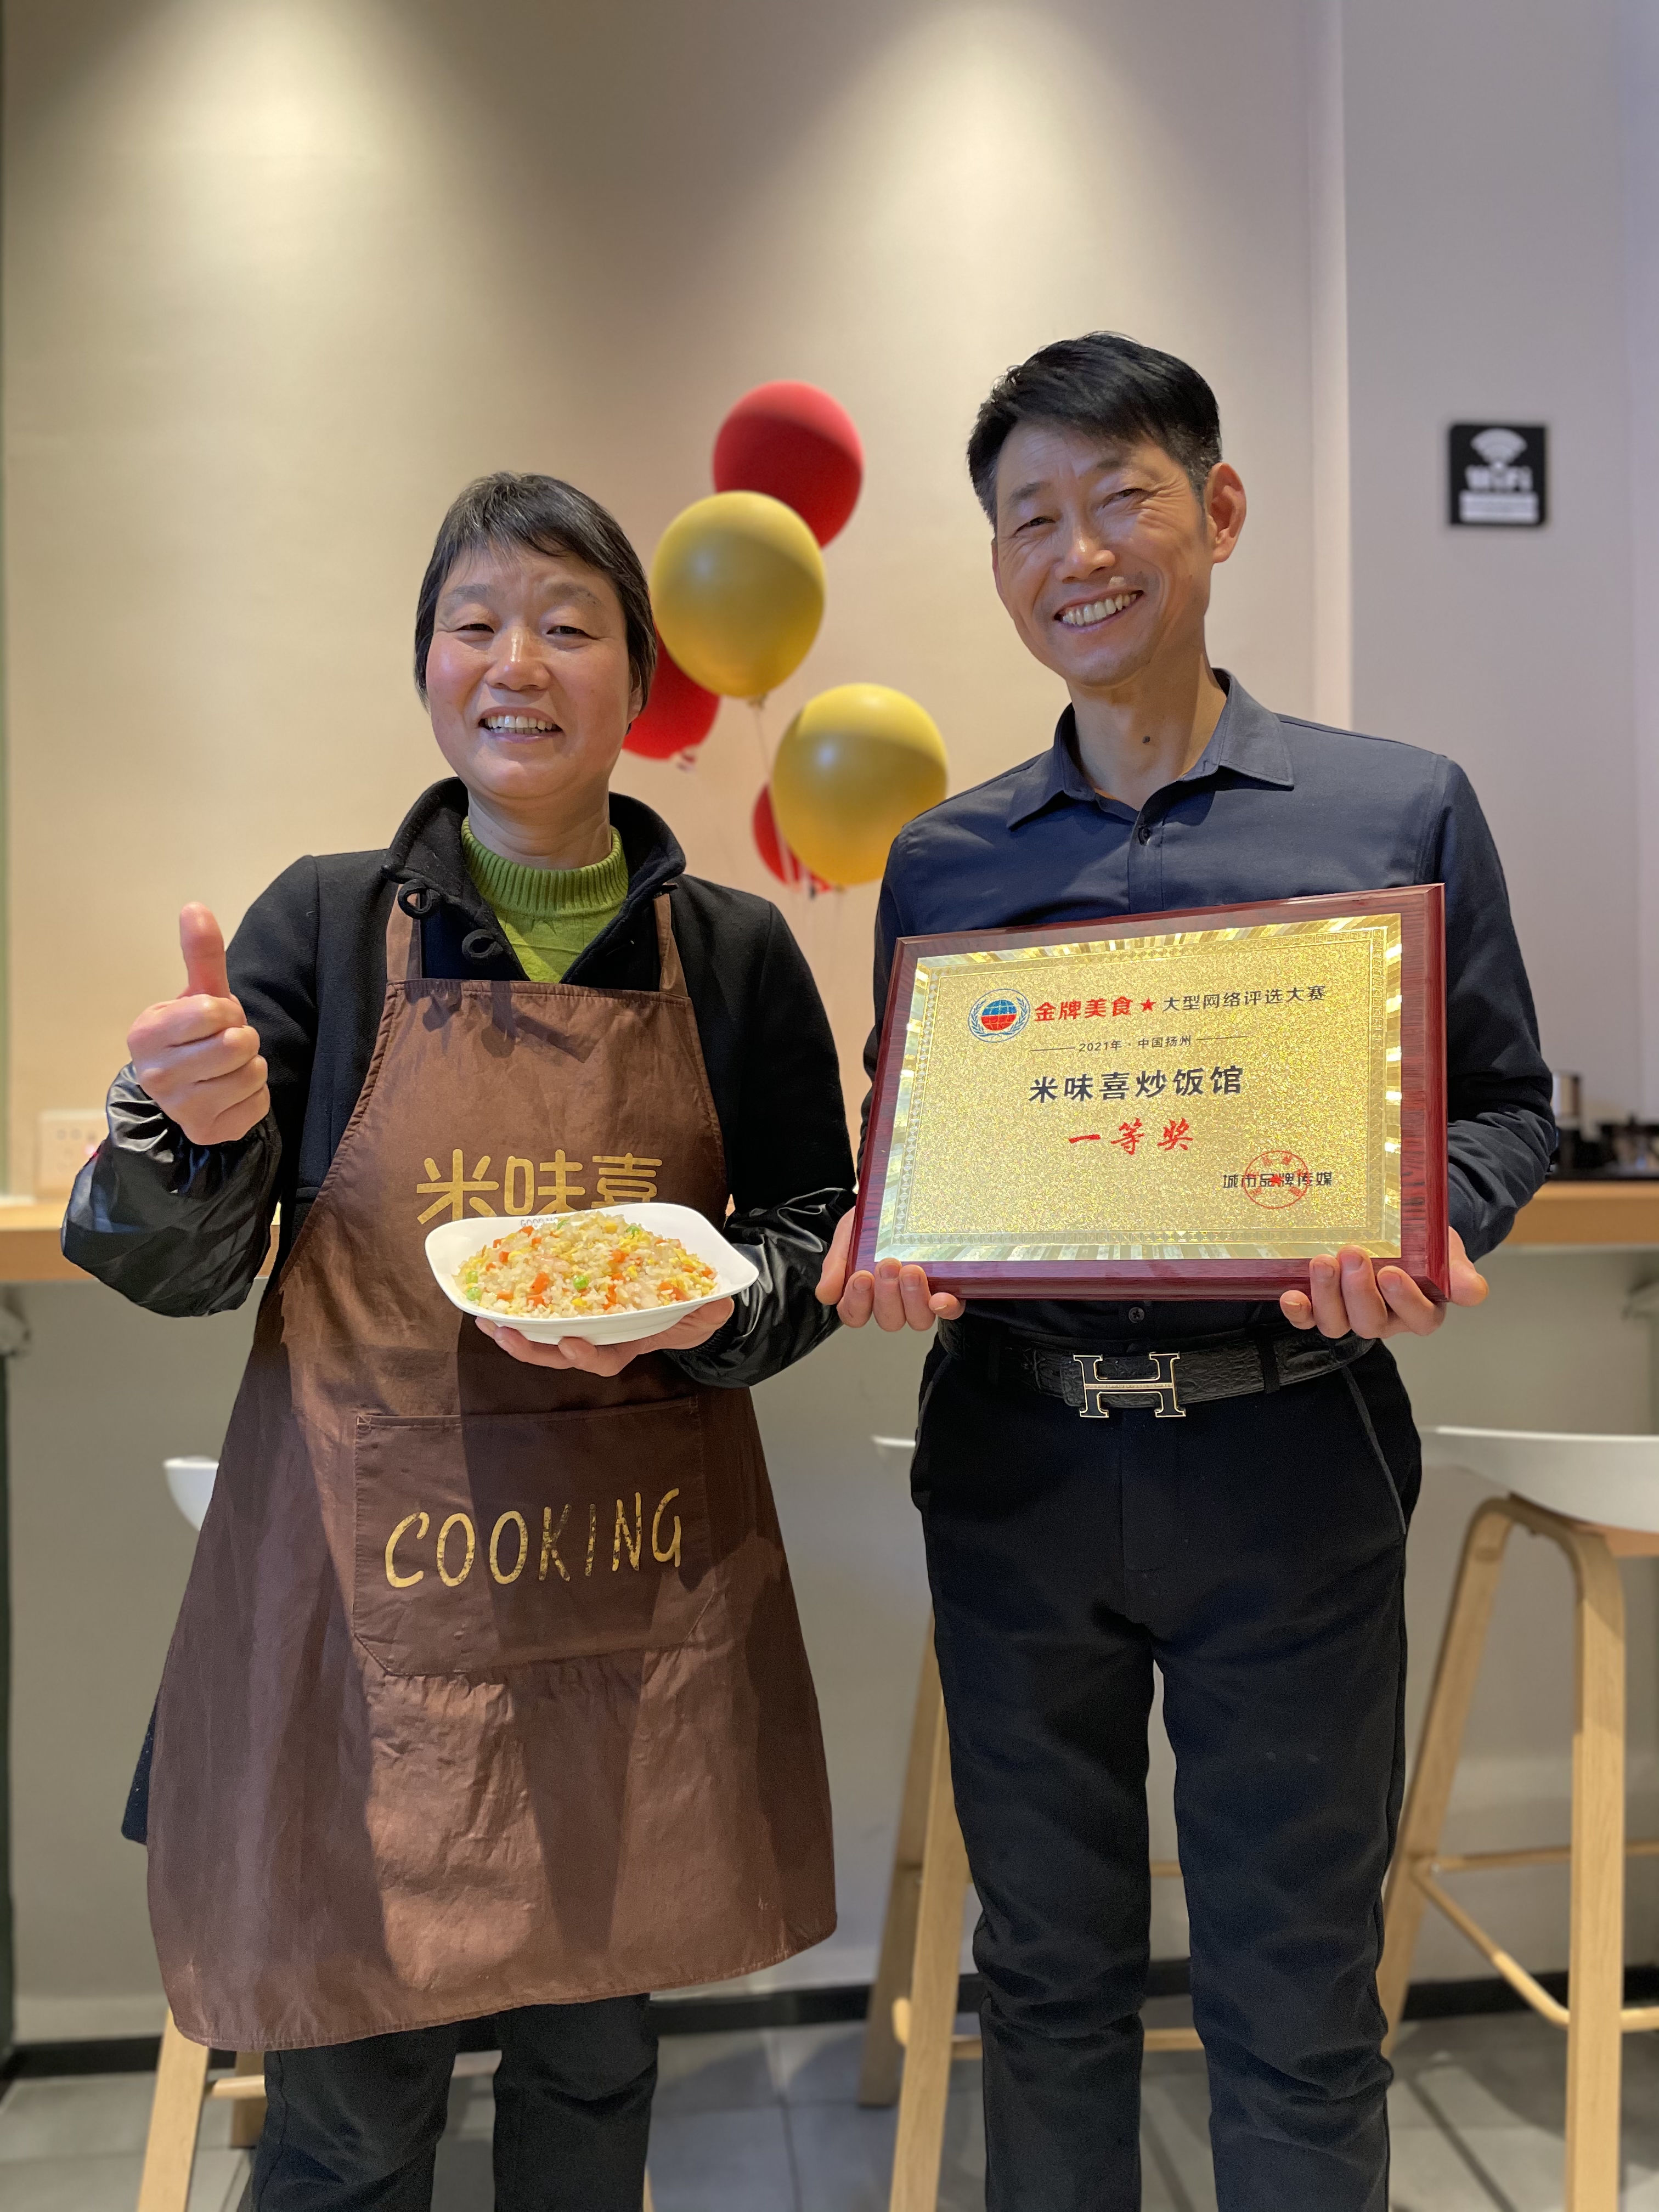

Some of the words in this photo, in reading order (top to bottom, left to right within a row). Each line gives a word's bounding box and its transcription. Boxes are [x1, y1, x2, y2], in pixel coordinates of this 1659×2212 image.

[1034, 996, 1133, 1022] 金牌美食
[1163, 985, 1326, 1013] 大型网络评选大赛
[1028, 1065, 1243, 1103] 米味喜炒饭馆
[1068, 1117, 1194, 1155] 一等奖
[416, 1148, 663, 1224] 米味喜
[1222, 1171, 1333, 1188] 城市品牌传媒
[385, 1488, 681, 1588] COOKING
